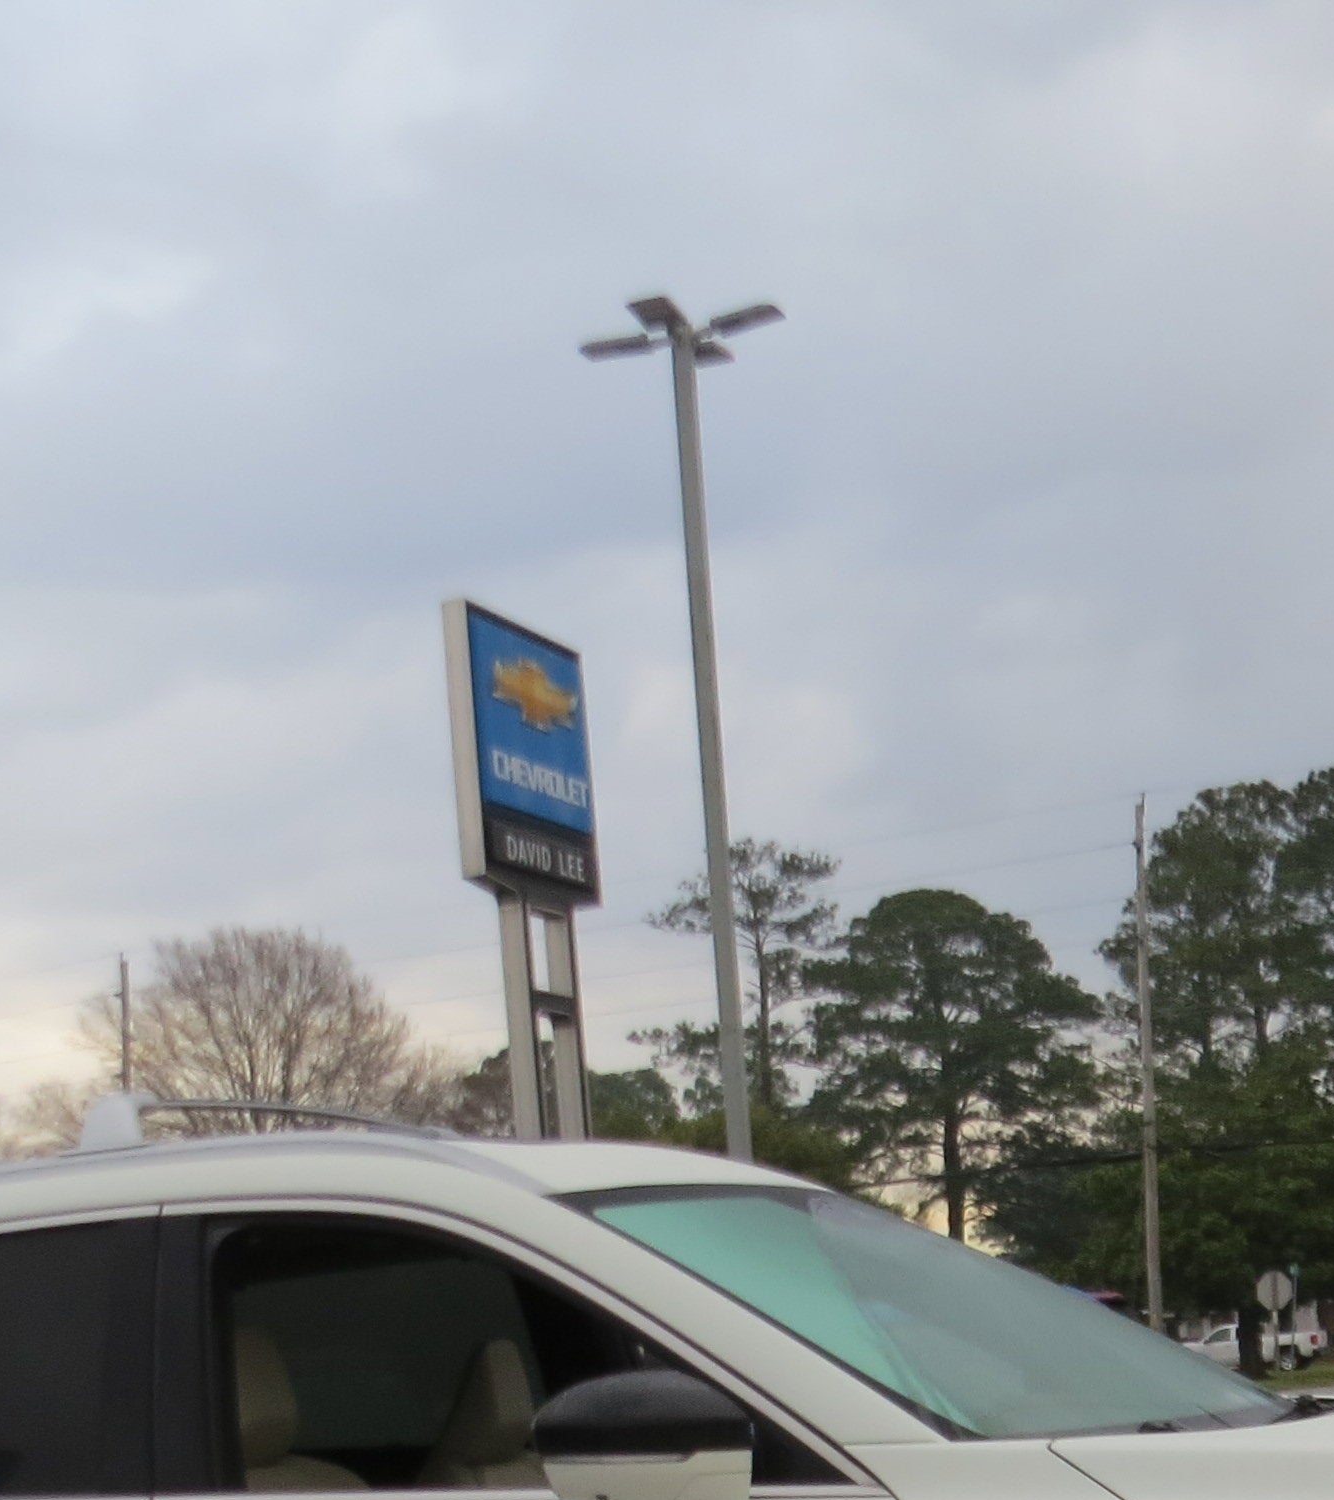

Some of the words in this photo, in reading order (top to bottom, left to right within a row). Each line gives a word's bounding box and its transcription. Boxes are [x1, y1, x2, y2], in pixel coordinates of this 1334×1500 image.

[492, 750, 588, 808] CHEVROLET
[506, 835, 552, 872] DAVID
[558, 853, 585, 883] LEE
